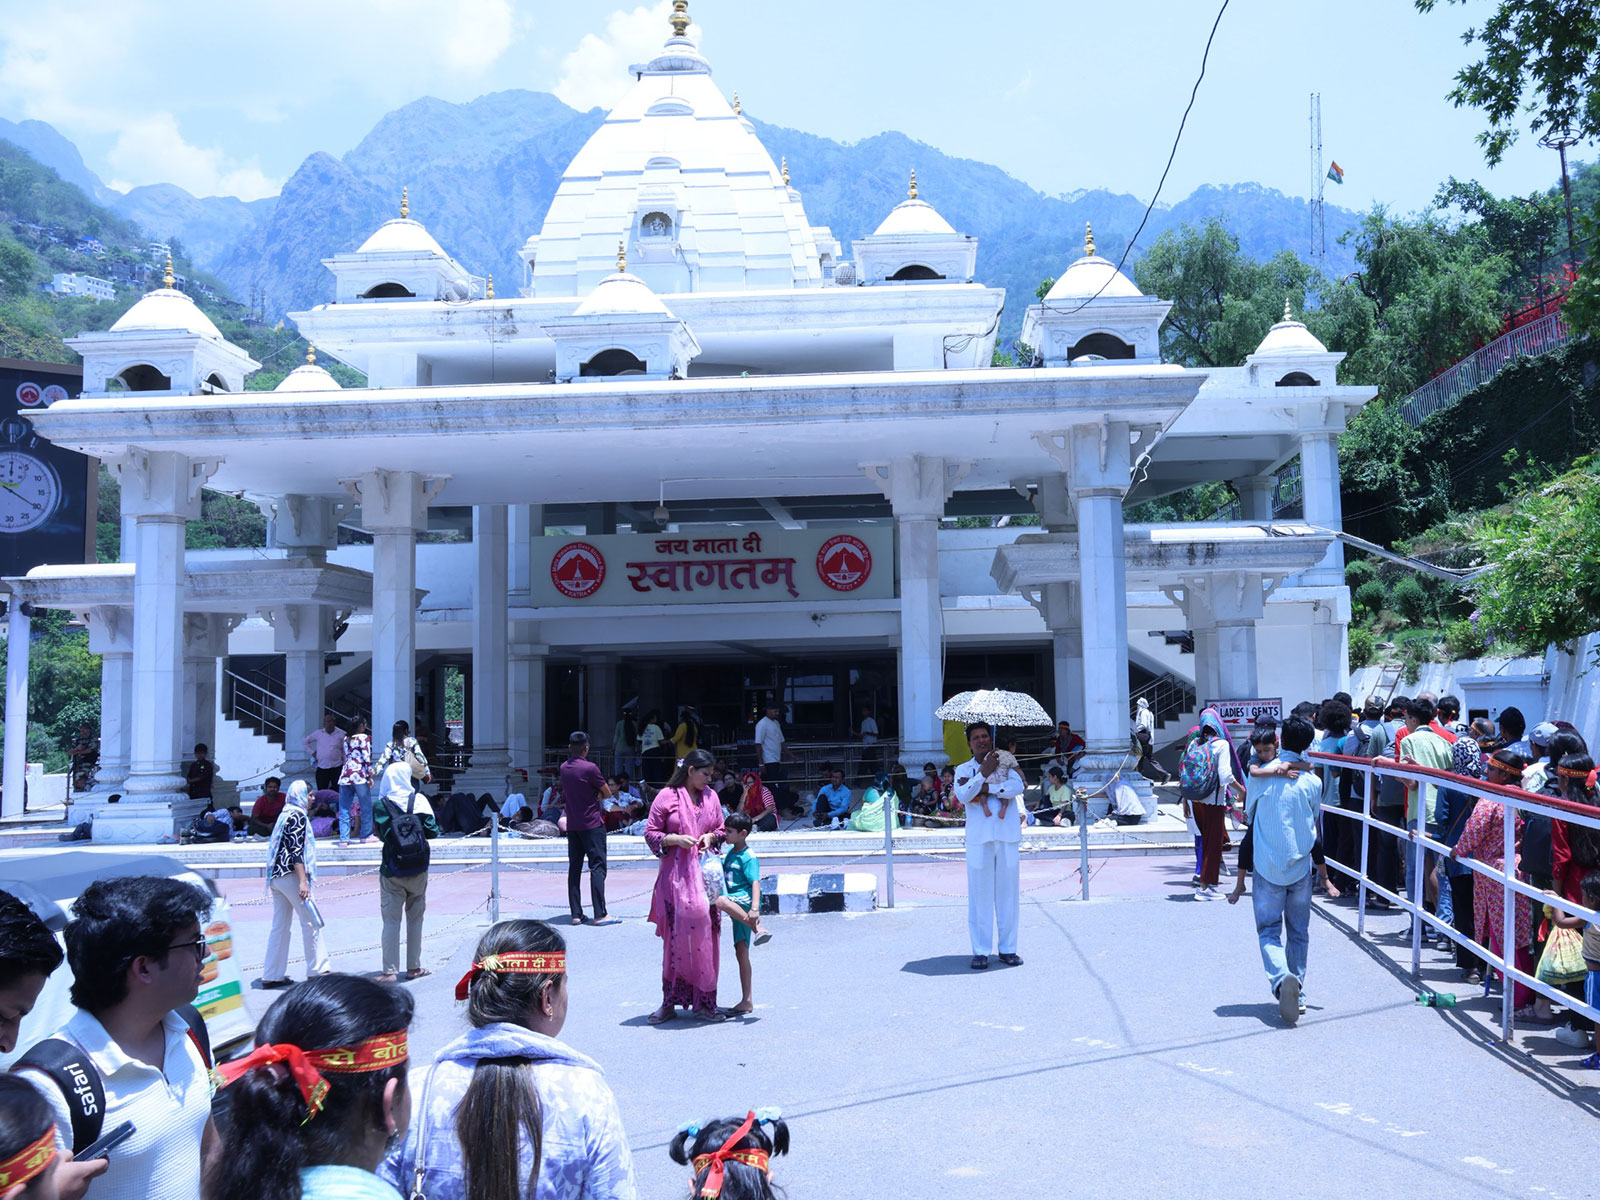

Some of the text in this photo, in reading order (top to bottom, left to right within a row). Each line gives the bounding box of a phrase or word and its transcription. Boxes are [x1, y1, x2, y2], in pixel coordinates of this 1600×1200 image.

[5, 515, 15, 523] 30
[20, 512, 30, 520] 25
[655, 531, 762, 555] जय माता दी
[626, 558, 799, 598] स्वागतम्
[1220, 706, 1279, 718] LADIES GENTS
[532, 957, 546, 968] दी
[320, 1048, 357, 1065] से
[63, 1063, 98, 1116] safari
